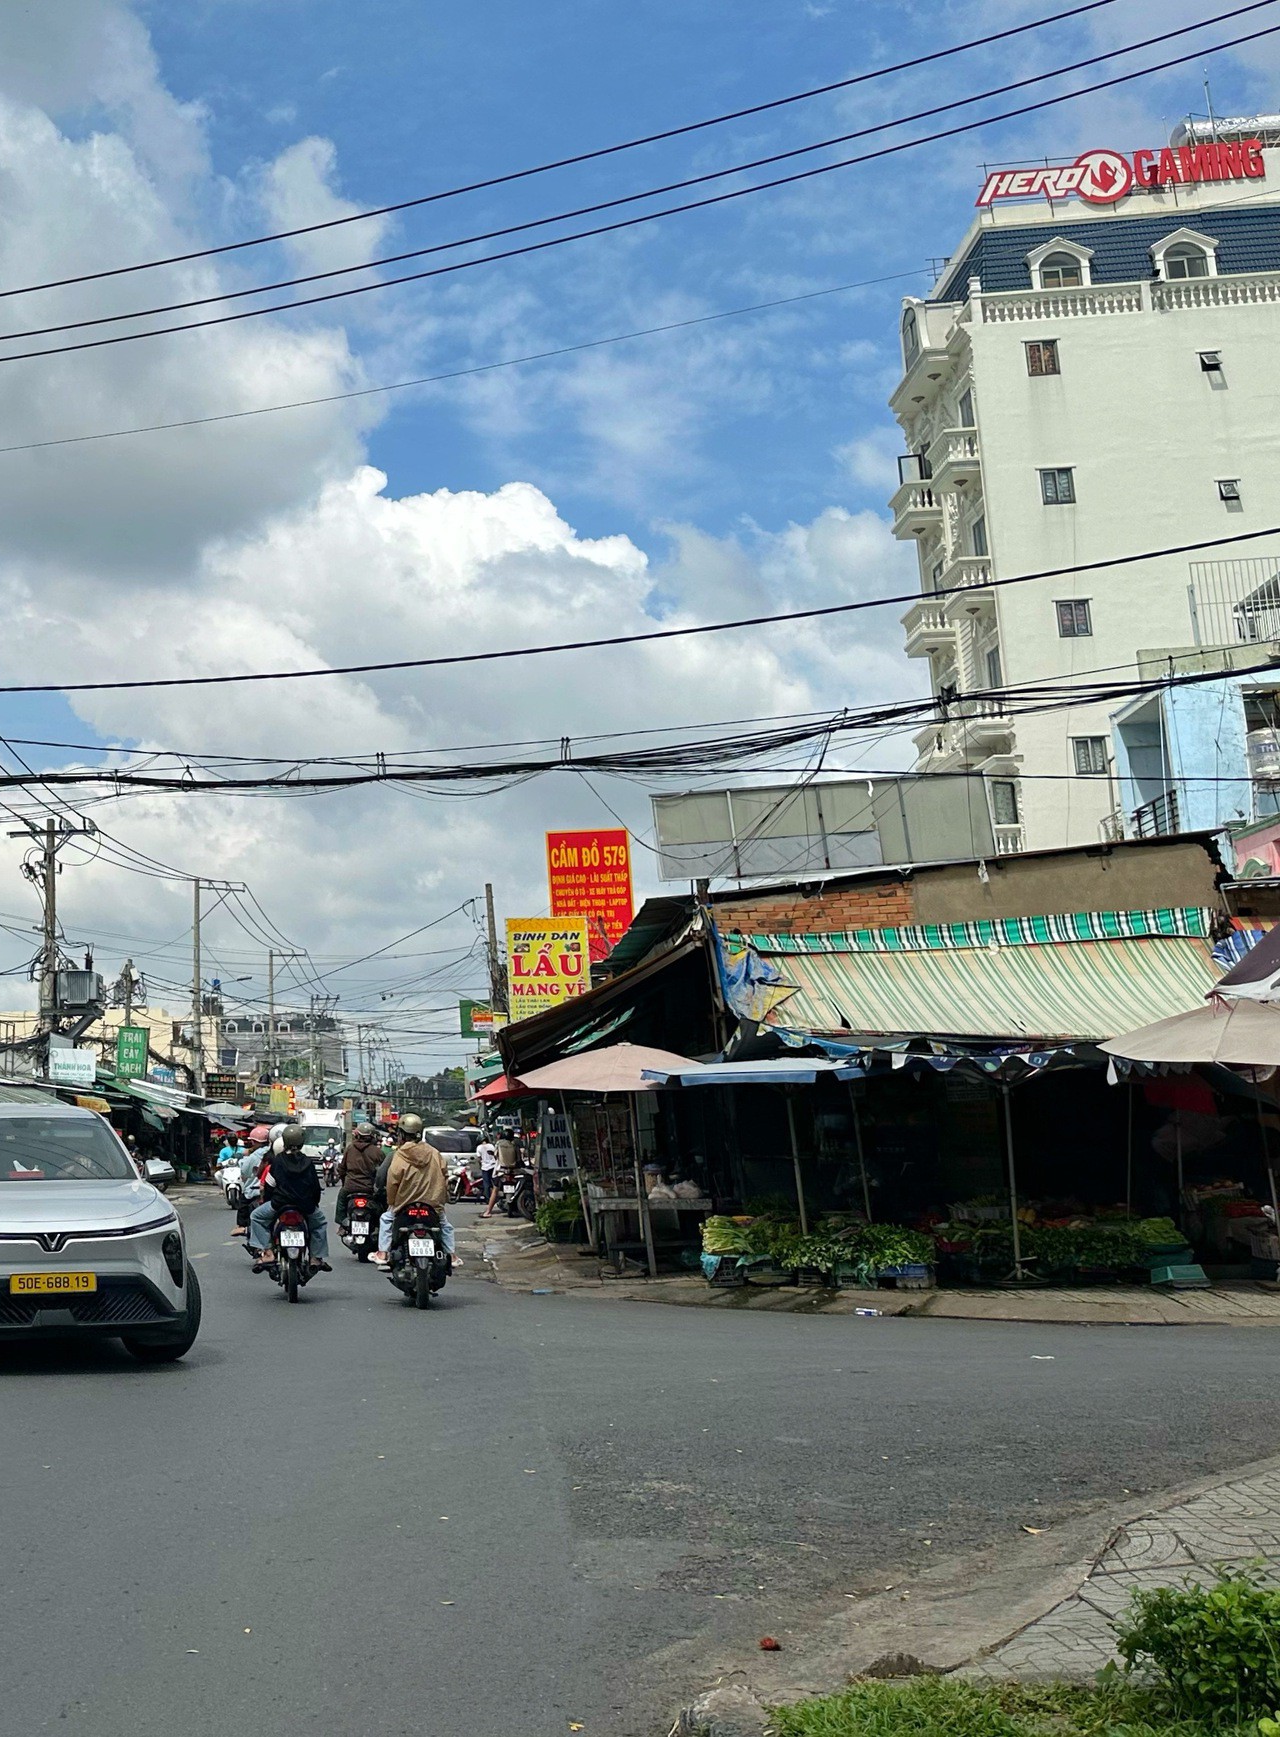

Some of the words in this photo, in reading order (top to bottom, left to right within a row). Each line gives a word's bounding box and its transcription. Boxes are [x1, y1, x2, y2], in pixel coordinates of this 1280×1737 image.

[977, 166, 1084, 206] HERO
[1133, 139, 1265, 188] GAMING
[551, 841, 578, 868] CẦM
[582, 838, 600, 867] ĐỒ
[603, 846, 626, 866] 579
[551, 930, 580, 941] DÂN
[511, 942, 584, 978] LẨU
[512, 983, 560, 996] MANG
